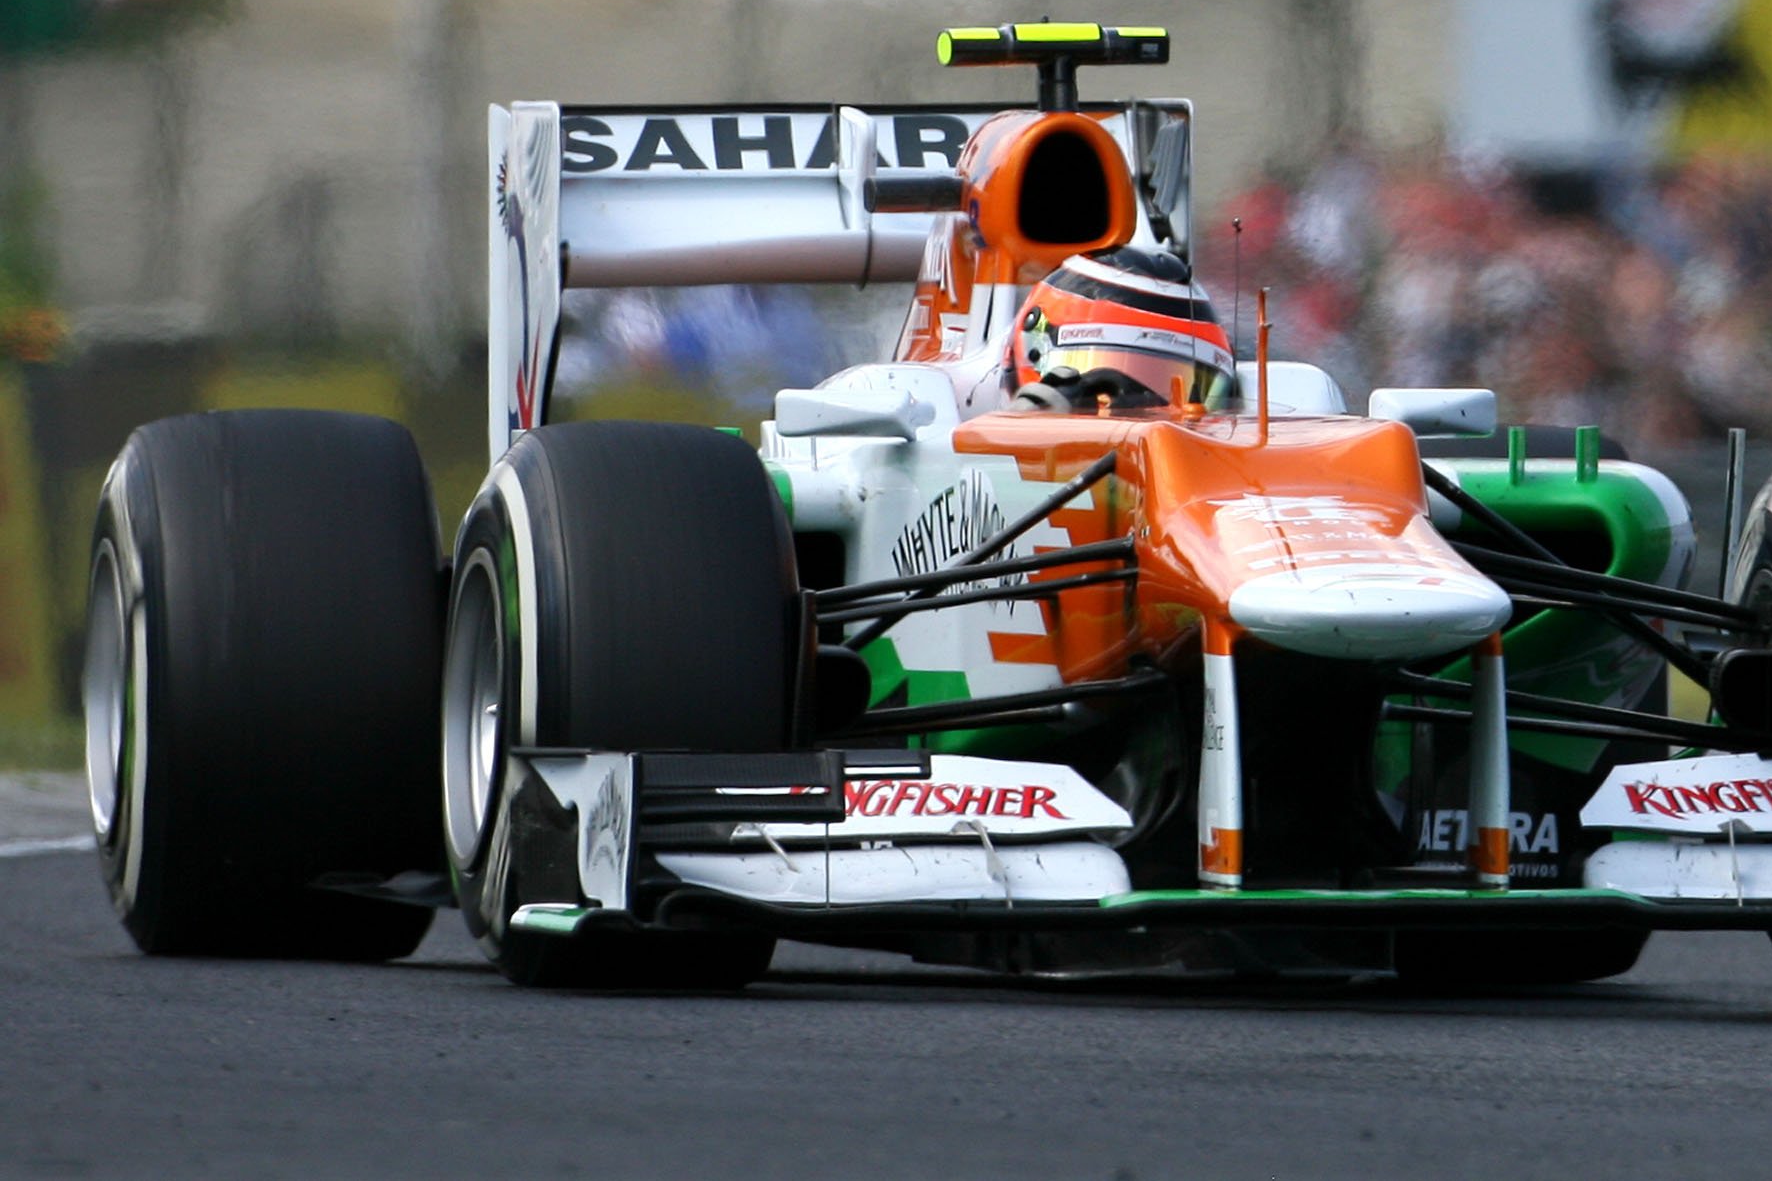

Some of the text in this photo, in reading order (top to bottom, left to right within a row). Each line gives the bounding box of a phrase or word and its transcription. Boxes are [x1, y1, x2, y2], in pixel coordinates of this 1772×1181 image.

[563, 116, 970, 171] SAHAR
[844, 780, 1076, 820] NGFISHER
[1418, 810, 1559, 853] AETRA
